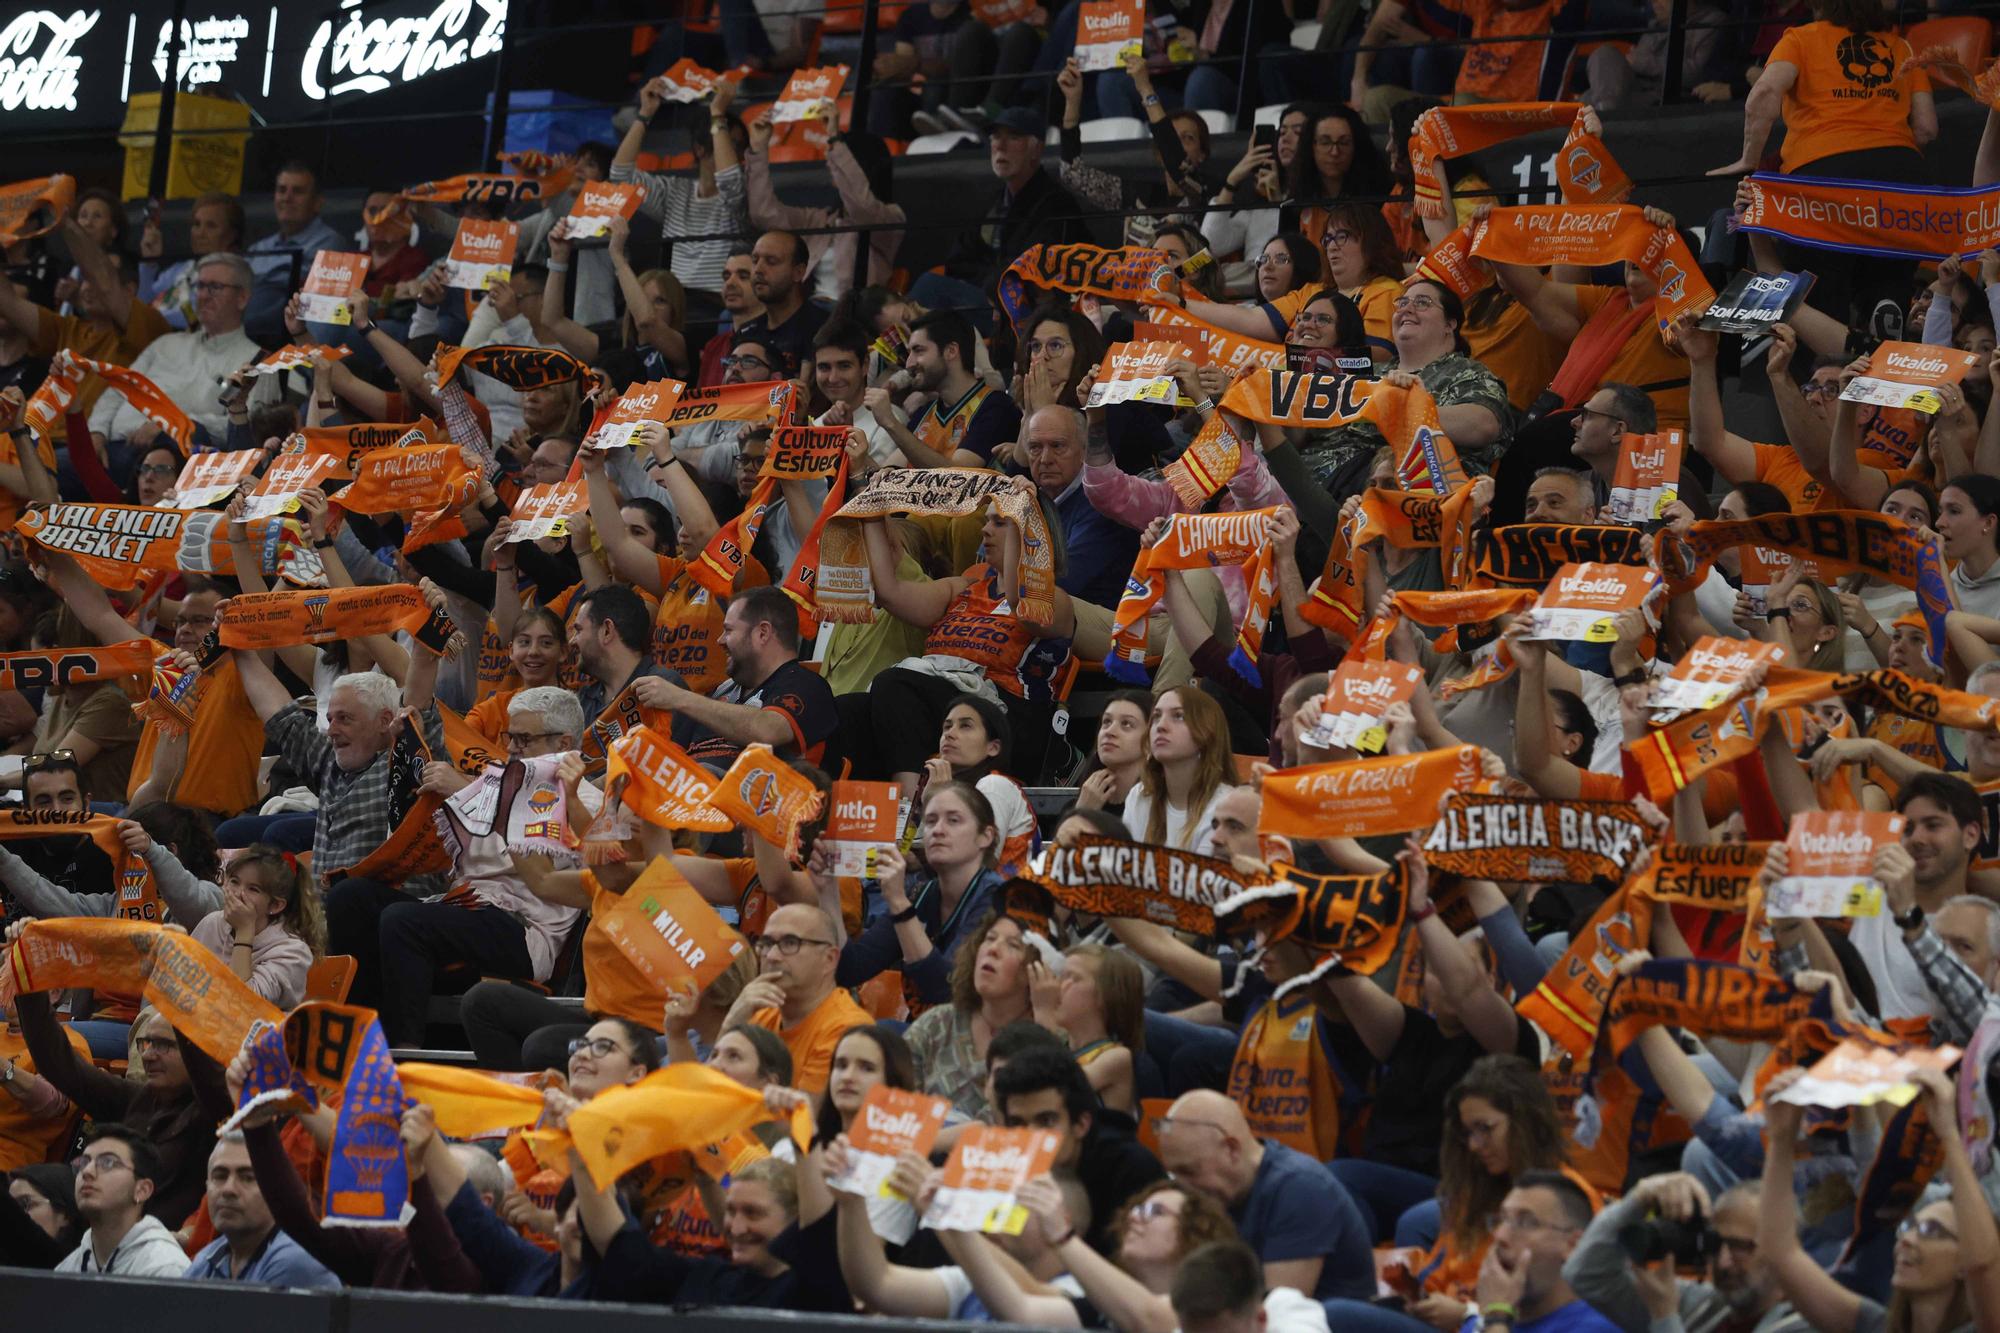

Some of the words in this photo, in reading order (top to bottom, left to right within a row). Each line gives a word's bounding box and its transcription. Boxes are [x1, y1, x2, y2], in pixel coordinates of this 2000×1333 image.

[1511, 154, 1558, 205] 11
[1037, 243, 1127, 291] VBC
[1337, 358, 1370, 369] Vitaldin
[1886, 351, 1949, 375] Vitaldin
[1268, 370, 1383, 421] VBC
[34, 525, 155, 564] BASKET
[47, 503, 183, 539] VALENCIA
[1759, 515, 1893, 573] VBC
[653, 909, 706, 970] MILAR
